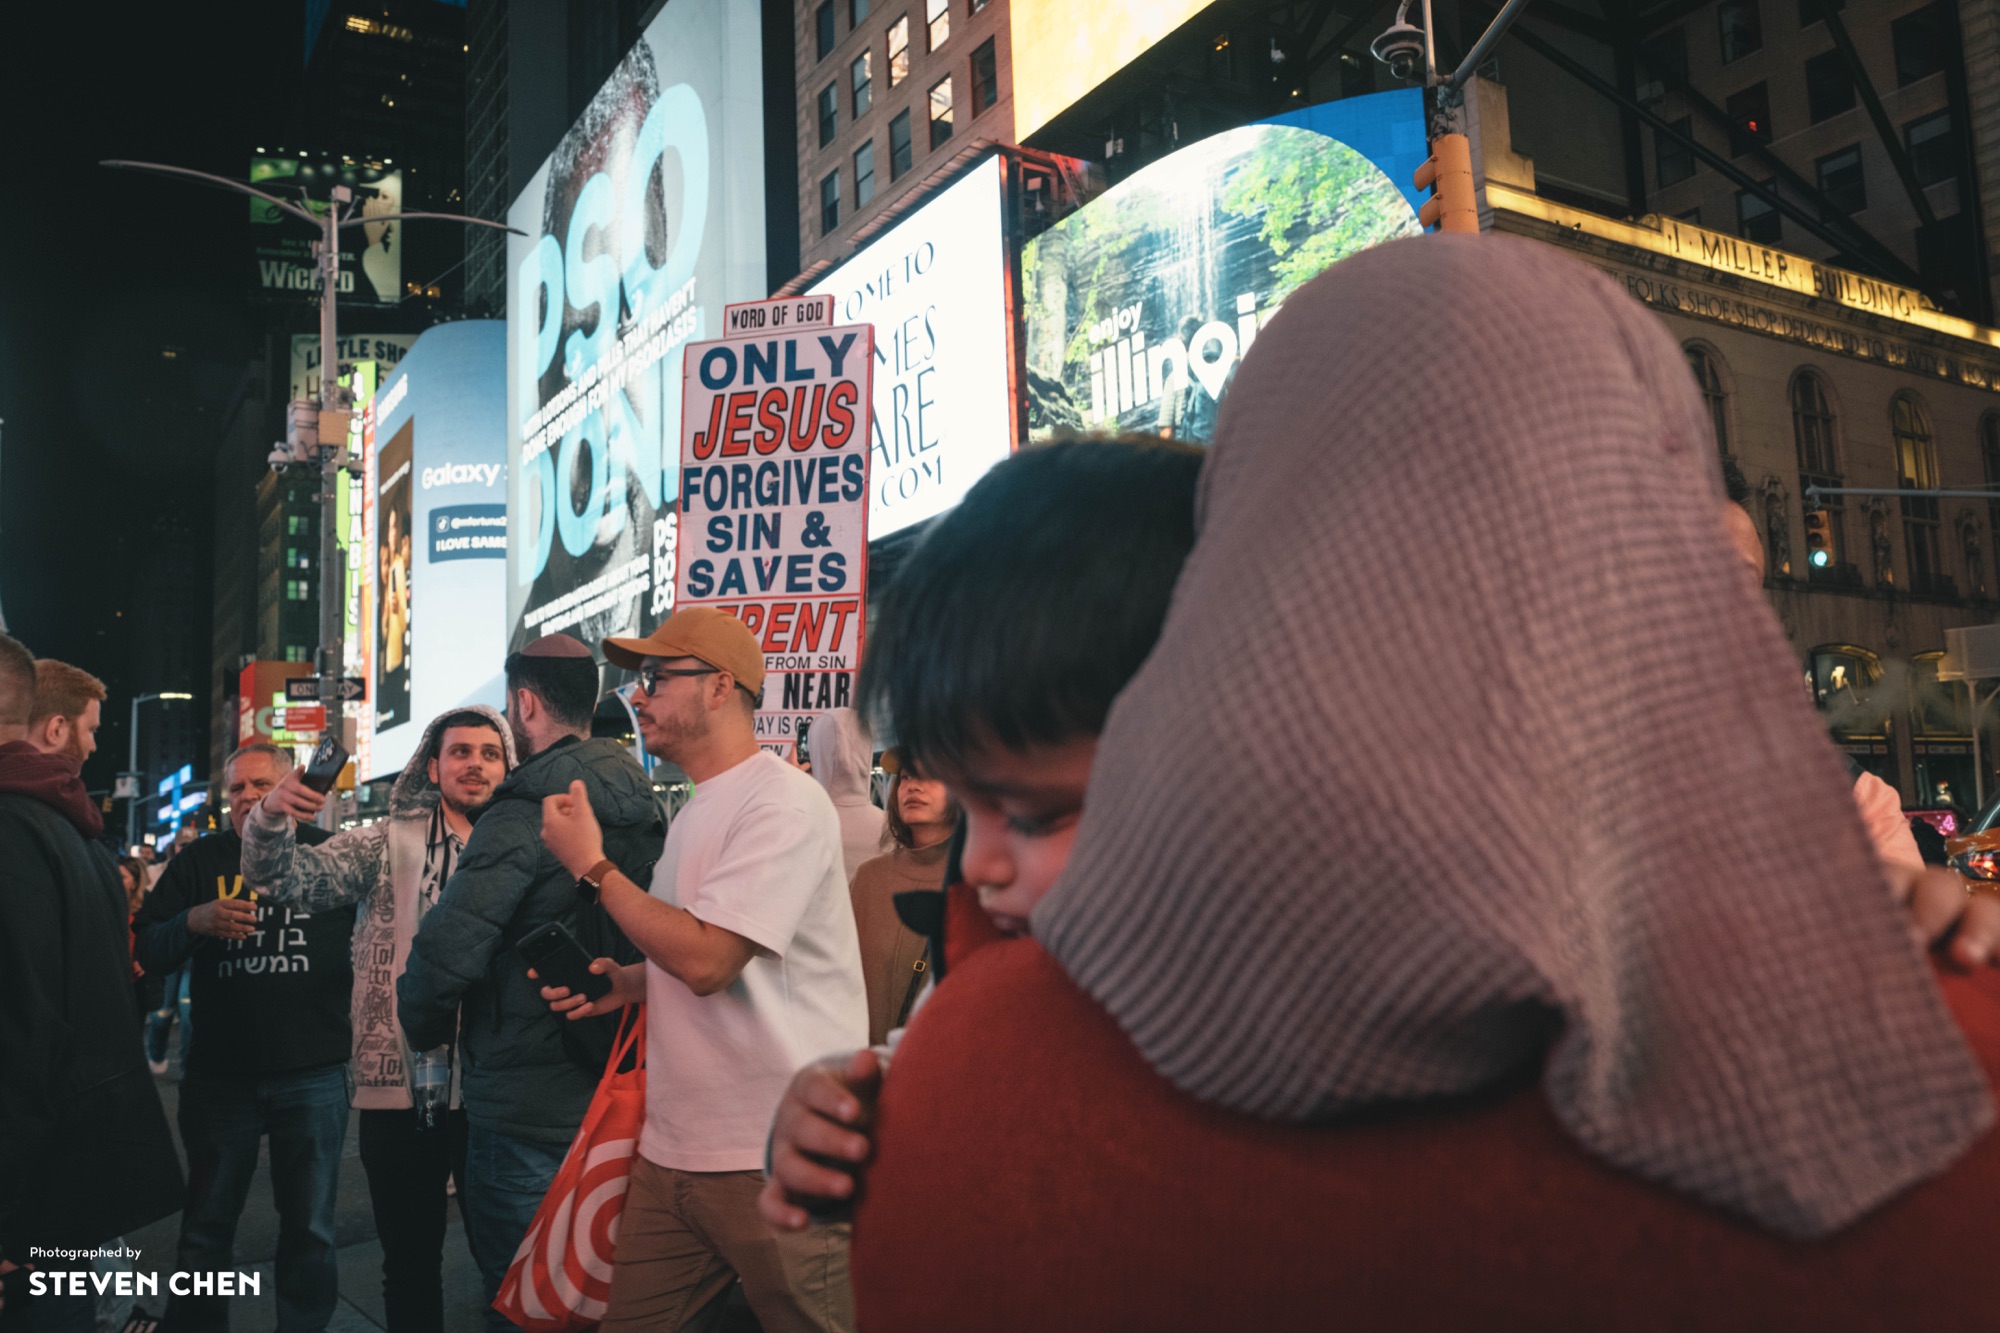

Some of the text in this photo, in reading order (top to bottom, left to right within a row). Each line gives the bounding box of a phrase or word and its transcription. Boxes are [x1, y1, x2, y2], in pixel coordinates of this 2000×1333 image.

[835, 241, 934, 321] OME TO
[1700, 233, 1792, 284] MILLER
[1811, 264, 1911, 317] BUILDING
[731, 301, 823, 330] WORD OF GOD
[1089, 301, 1143, 344] enjoy
[1627, 275, 1680, 308] FOLKS
[1687, 291, 1730, 320] SHOE
[1735, 304, 1777, 332] SHOP
[1782, 315, 1859, 354] DEDICATED
[307, 338, 370, 371] LITLE
[578, 364, 596, 396] AND
[623, 325, 648, 356] THAT
[650, 277, 695, 341] HAVEN'T
[588, 379, 609, 414] FOR
[628, 306, 697, 382] PSORIASIS
[699, 333, 858, 390] ONLY
[1090, 292, 1281, 424] illinoi
[693, 379, 858, 460] JESUS
[421, 462, 501, 490] Galaxy
[682, 453, 864, 513] FORGIVES
[441, 536, 470, 551] LOVE
[706, 511, 832, 553] SIN &
[687, 552, 847, 598] SAVES
[765, 655, 846, 669] FROM SIN
[337, 683, 354, 695] AY
[782, 672, 850, 710] NEAR
[753, 716, 774, 734] AY
[778, 716, 790, 734] IS
[278, 928, 307, 953] בן
[218, 955, 309, 978] המשיח
